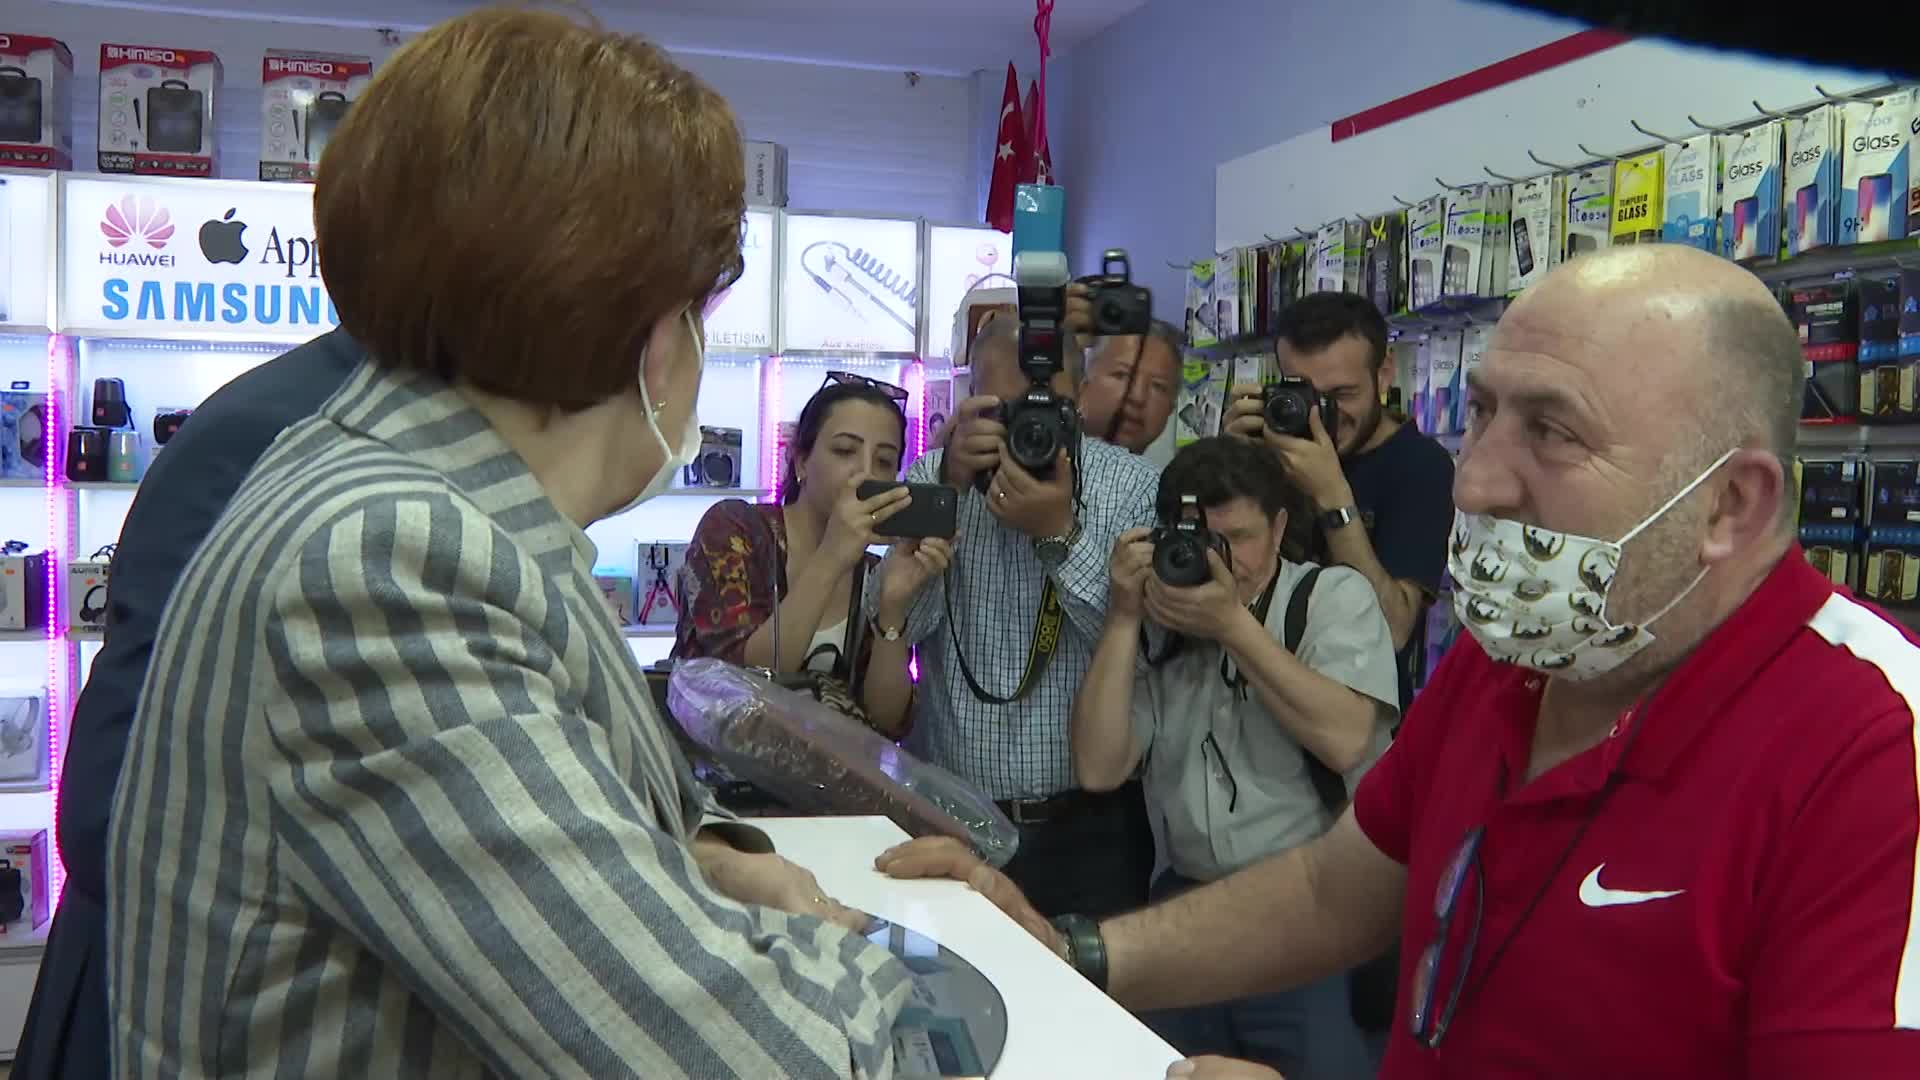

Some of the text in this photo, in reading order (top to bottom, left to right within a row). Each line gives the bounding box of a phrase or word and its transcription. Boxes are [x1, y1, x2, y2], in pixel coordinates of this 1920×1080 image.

[1853, 132, 1901, 153] Glass
[1791, 145, 1821, 167] Glass
[1728, 161, 1763, 180] Glass
[1617, 204, 1648, 222] GLASS
[100, 251, 175, 267] HUAWEI
[102, 278, 340, 325] SAMSUN
